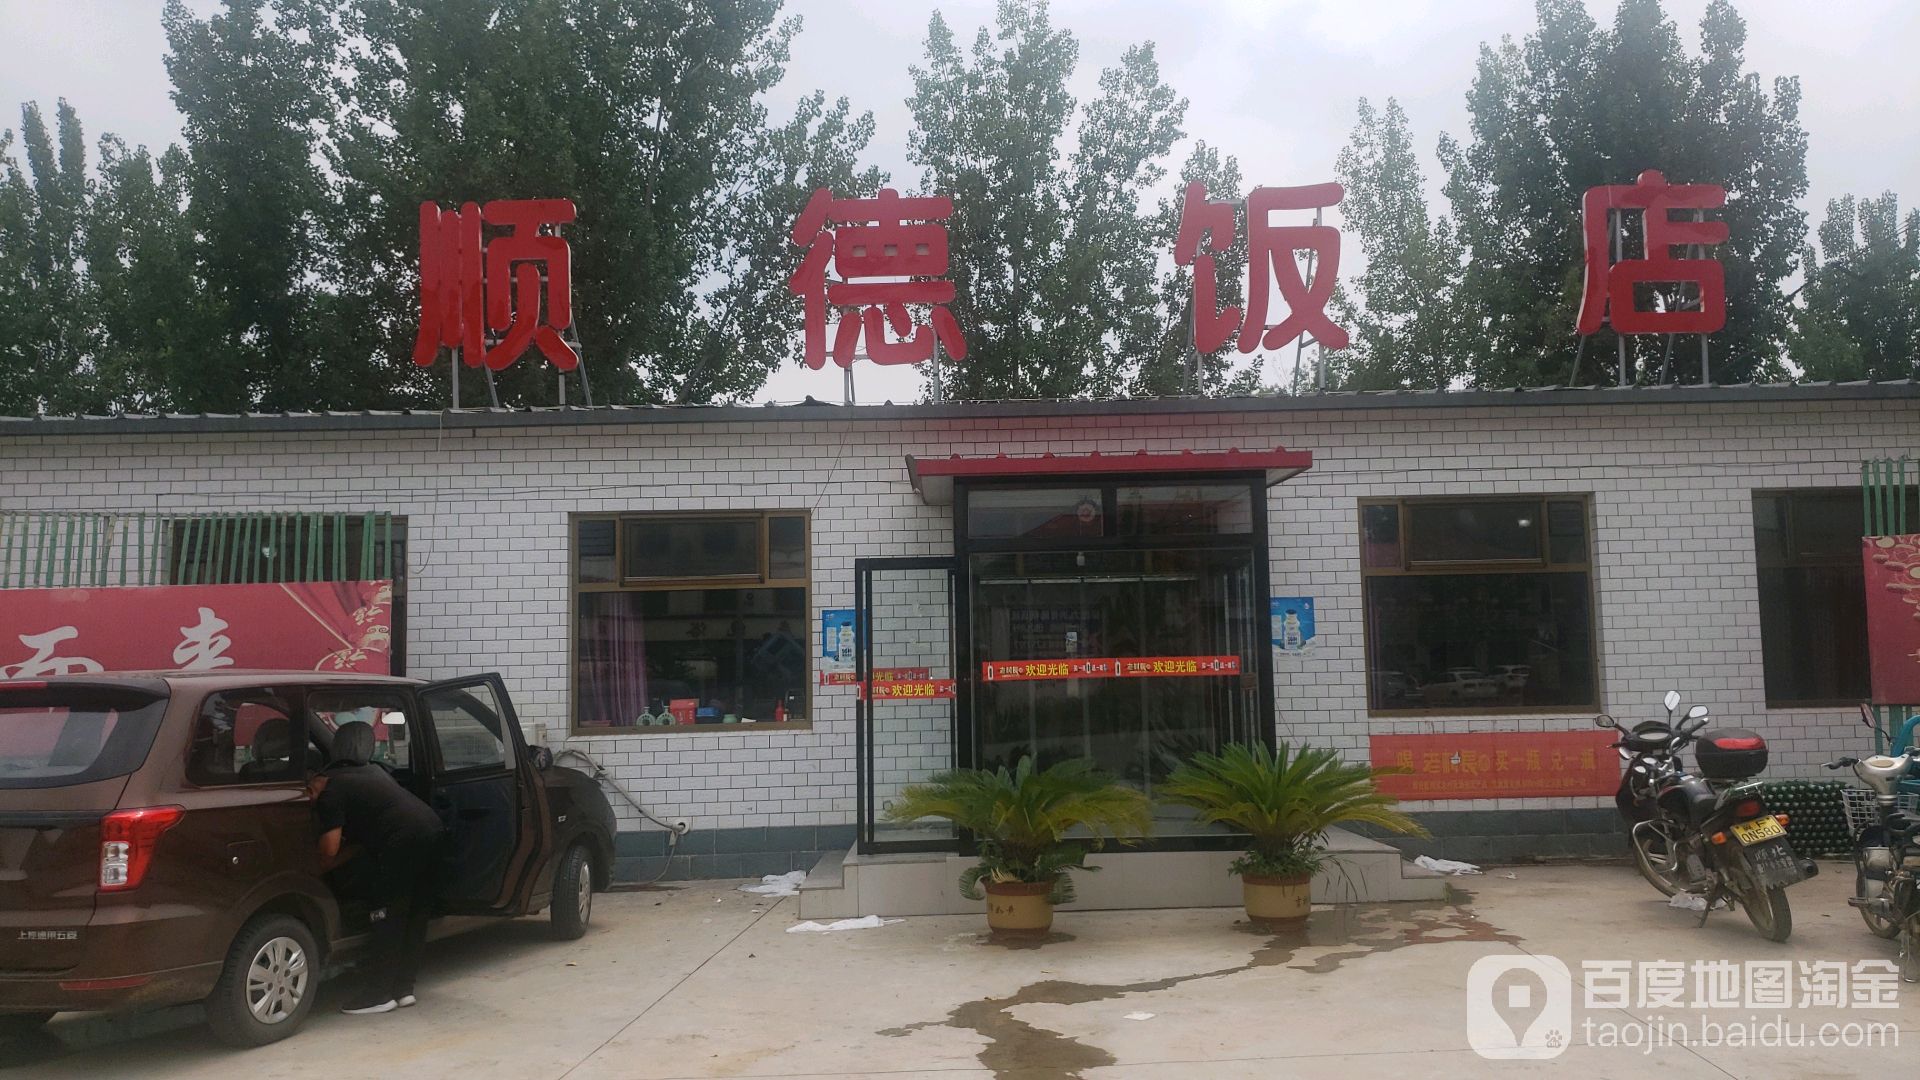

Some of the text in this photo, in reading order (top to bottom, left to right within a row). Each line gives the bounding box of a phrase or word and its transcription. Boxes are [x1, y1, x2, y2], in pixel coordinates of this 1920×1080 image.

[413, 168, 1730, 371] 顺德饭店
[1025, 663, 1069, 676] 欢迎光临
[1153, 660, 1197, 673] 欢迎光临
[892, 683, 935, 697] 欢迎光临
